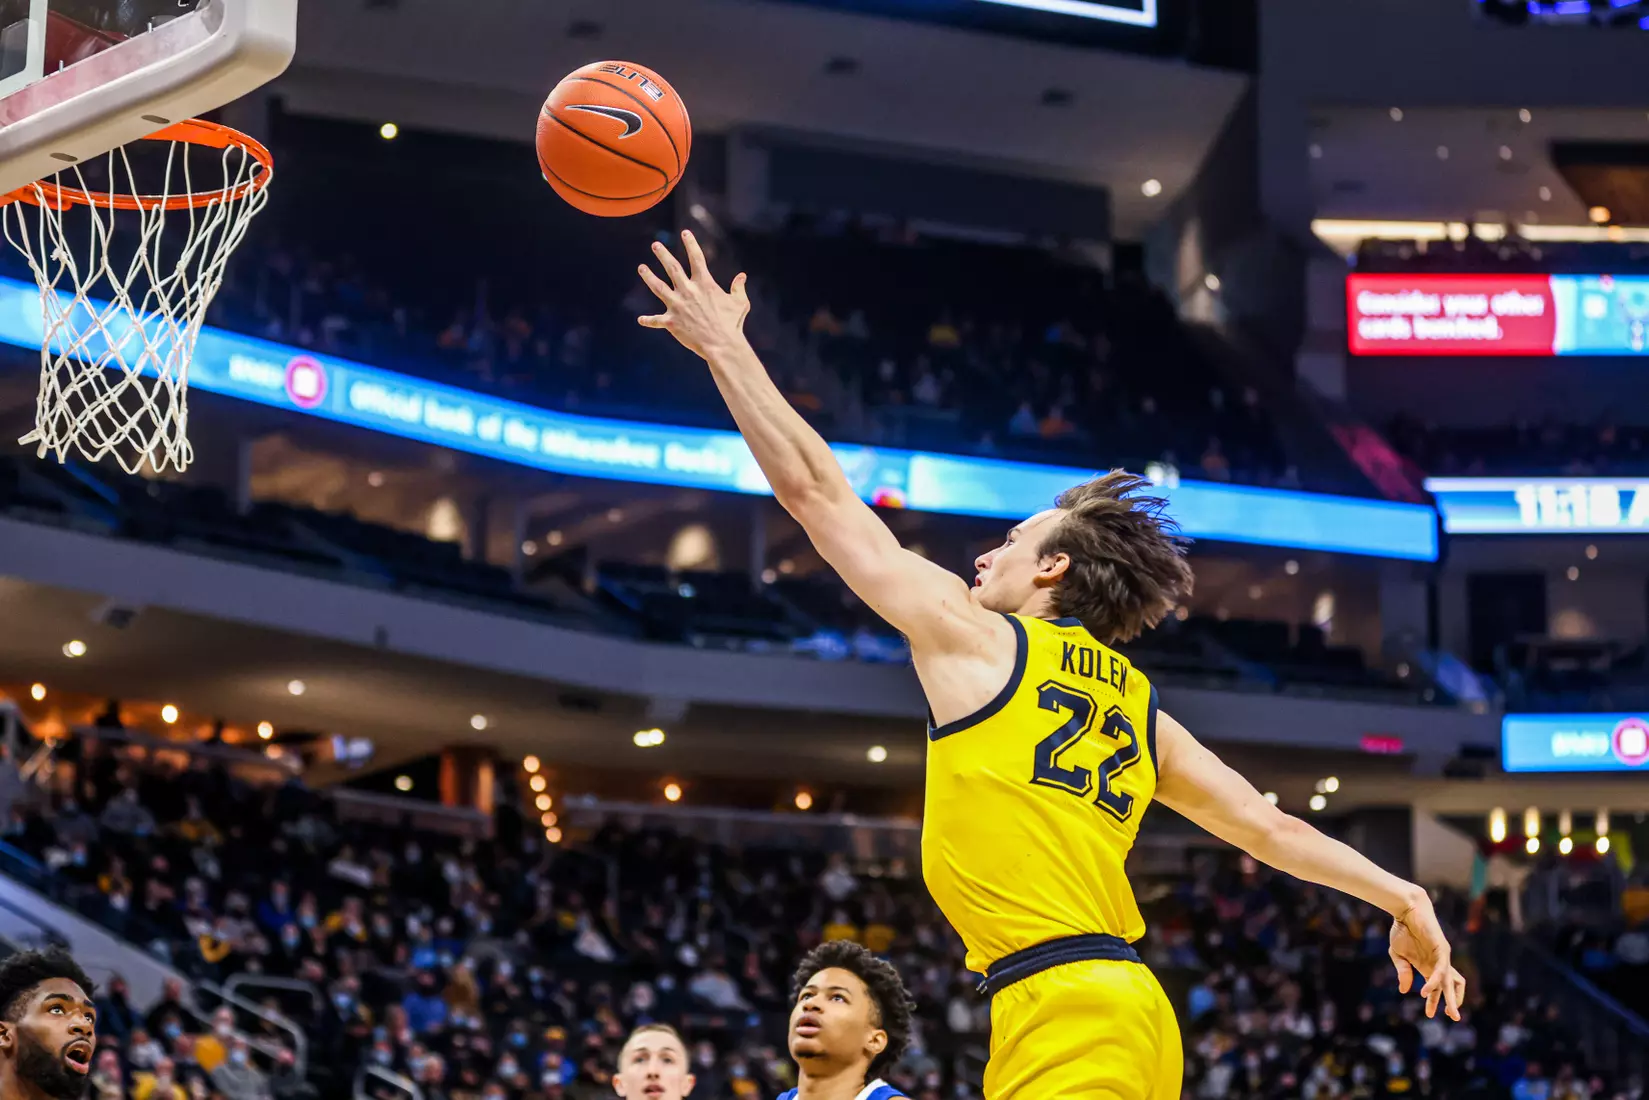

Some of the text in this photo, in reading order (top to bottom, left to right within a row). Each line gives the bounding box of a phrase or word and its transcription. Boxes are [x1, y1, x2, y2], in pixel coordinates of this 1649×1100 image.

[599, 64, 663, 102] ELITE
[1061, 641, 1128, 698] KOLEK
[1029, 679, 1141, 824] 22
